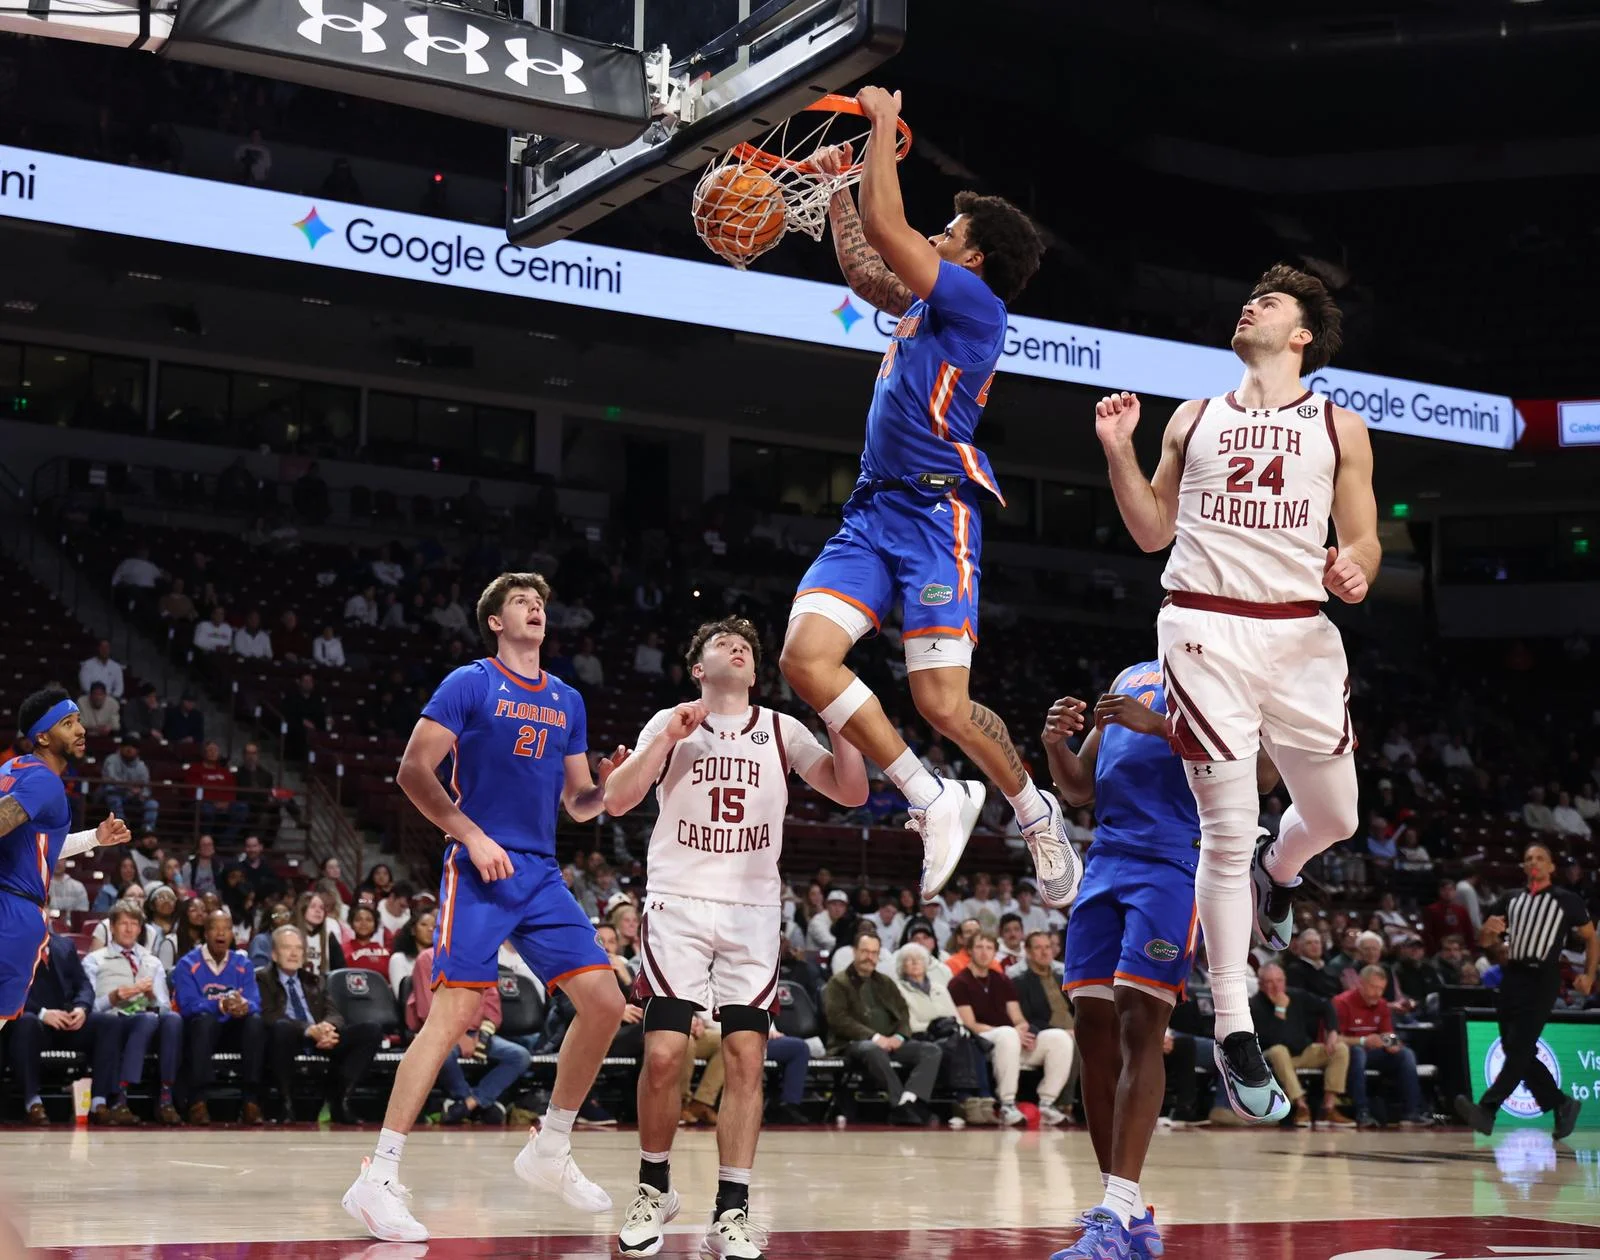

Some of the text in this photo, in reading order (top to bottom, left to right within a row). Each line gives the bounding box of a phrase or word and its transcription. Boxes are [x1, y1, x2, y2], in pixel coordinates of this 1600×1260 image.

[345, 218, 621, 294] Google Gemini
[1002, 325, 1100, 370] Gemini
[1298, 405, 1318, 418] SEC
[1310, 376, 1500, 434] Google Gemini
[1218, 425, 1301, 456] SOUTH
[1226, 456, 1284, 496] 24
[1200, 491, 1309, 529] CAROLINA
[494, 698, 567, 730] FLORIDA
[513, 725, 548, 760] 21
[751, 731, 769, 745] SEC
[692, 757, 760, 788] SOUTH
[708, 787, 746, 824] 15
[677, 819, 770, 854] CAROLINA
[1571, 1082, 1589, 1101] to
